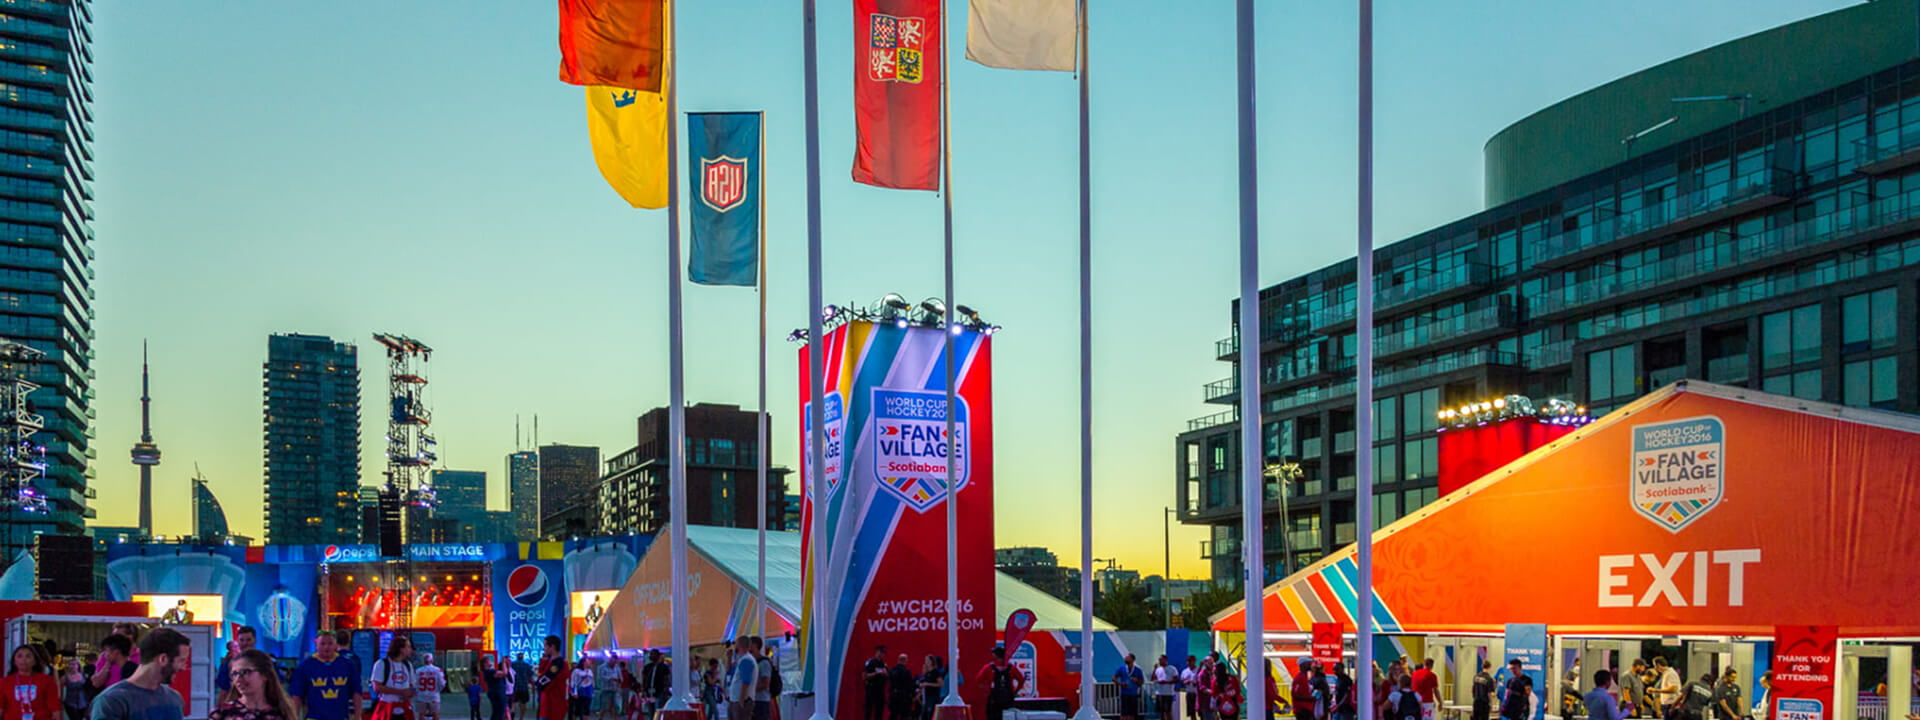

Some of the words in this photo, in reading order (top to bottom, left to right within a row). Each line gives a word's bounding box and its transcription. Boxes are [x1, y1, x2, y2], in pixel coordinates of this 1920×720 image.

[885, 397, 924, 407] WORLD
[901, 424, 940, 442] FAN
[1644, 428, 1681, 440] WORLD
[1683, 424, 1704, 435] CUP
[888, 461, 946, 472] Scotiaban
[1658, 451, 1695, 468] FAN
[1639, 464, 1716, 484] VILLAGE
[1645, 484, 1707, 498] Scotiabank
[443, 546, 483, 556] STAGE
[1598, 549, 1761, 607] EXIT
[510, 608, 546, 622] pepsi
[510, 623, 546, 637] LIVE
[1776, 655, 1808, 663] THANK
[419, 677, 436, 692] 99
[1776, 674, 1829, 682] ATTENDING
